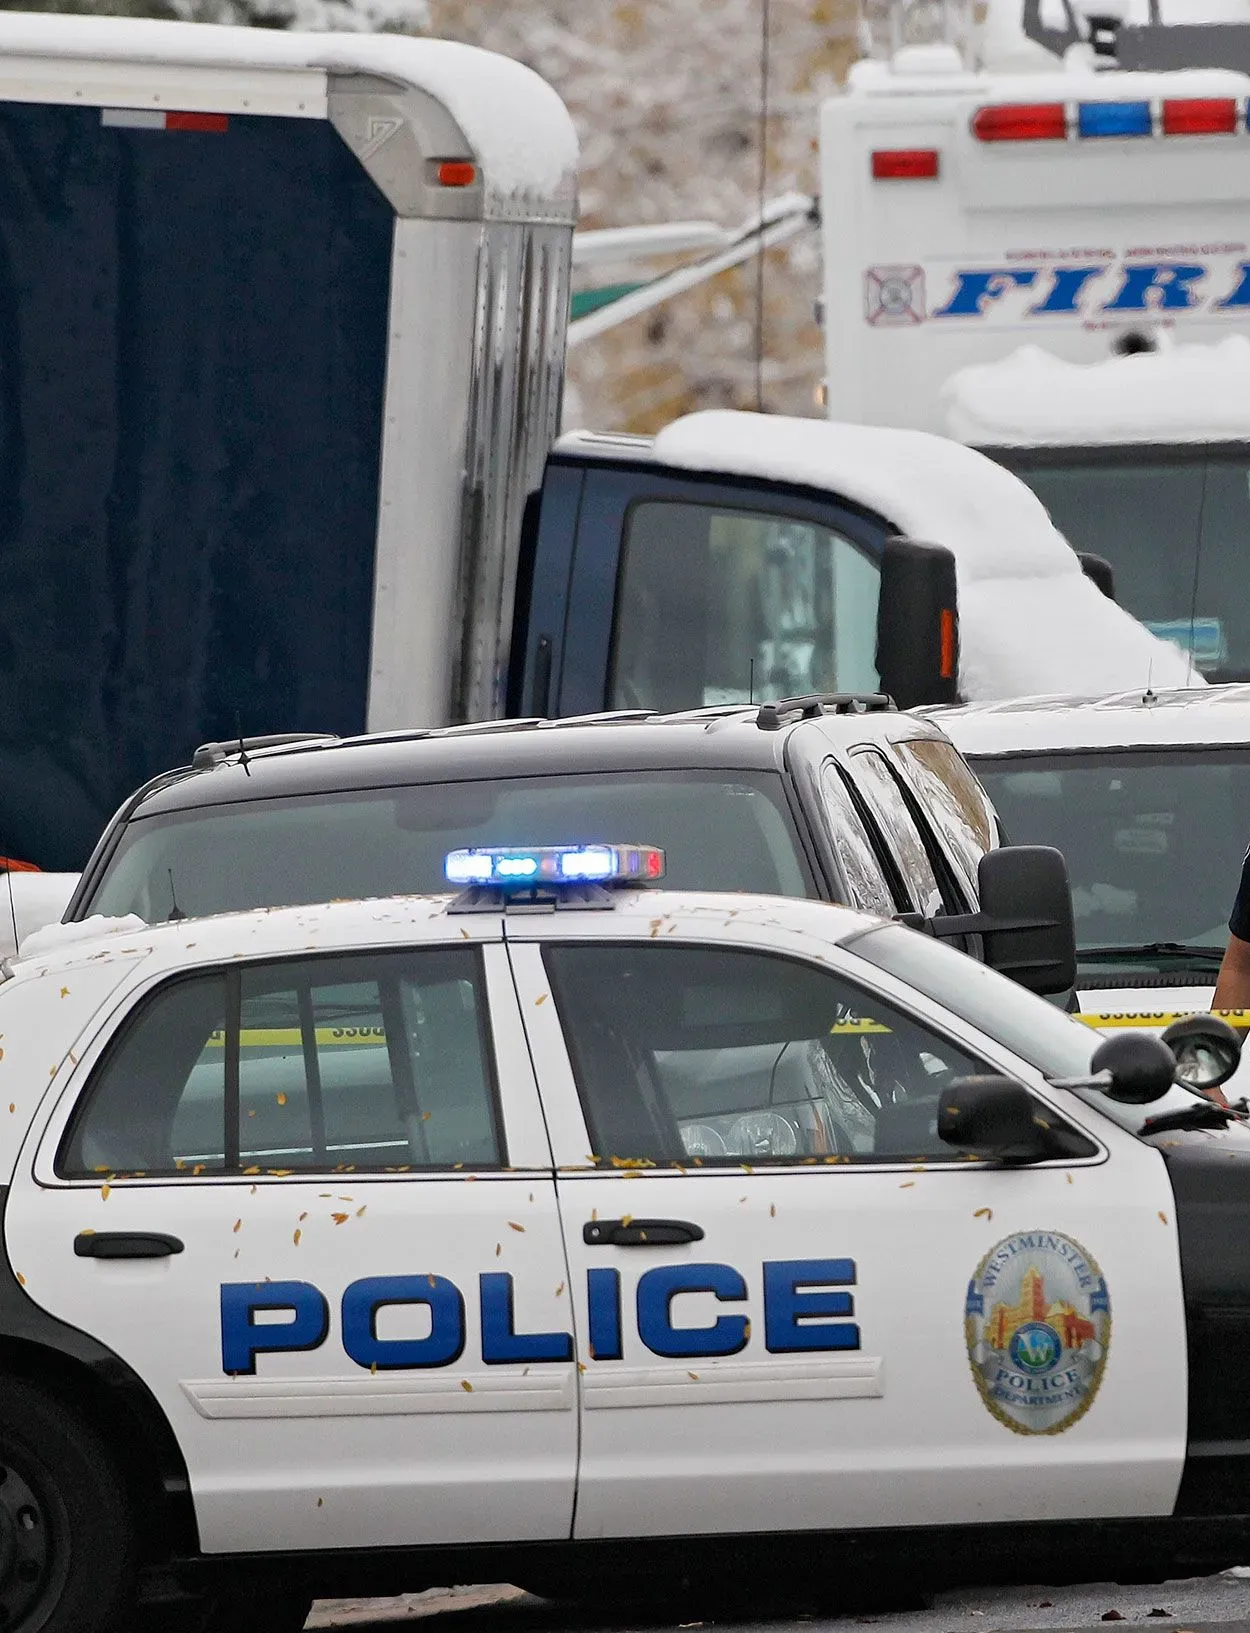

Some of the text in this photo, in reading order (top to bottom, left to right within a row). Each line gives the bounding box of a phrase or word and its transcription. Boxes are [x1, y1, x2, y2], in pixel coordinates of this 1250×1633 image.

[983, 1234, 1093, 1288] WESTMINSTER
[219, 1258, 862, 1376] POLICE
[995, 1367, 1081, 1392] POLICE
